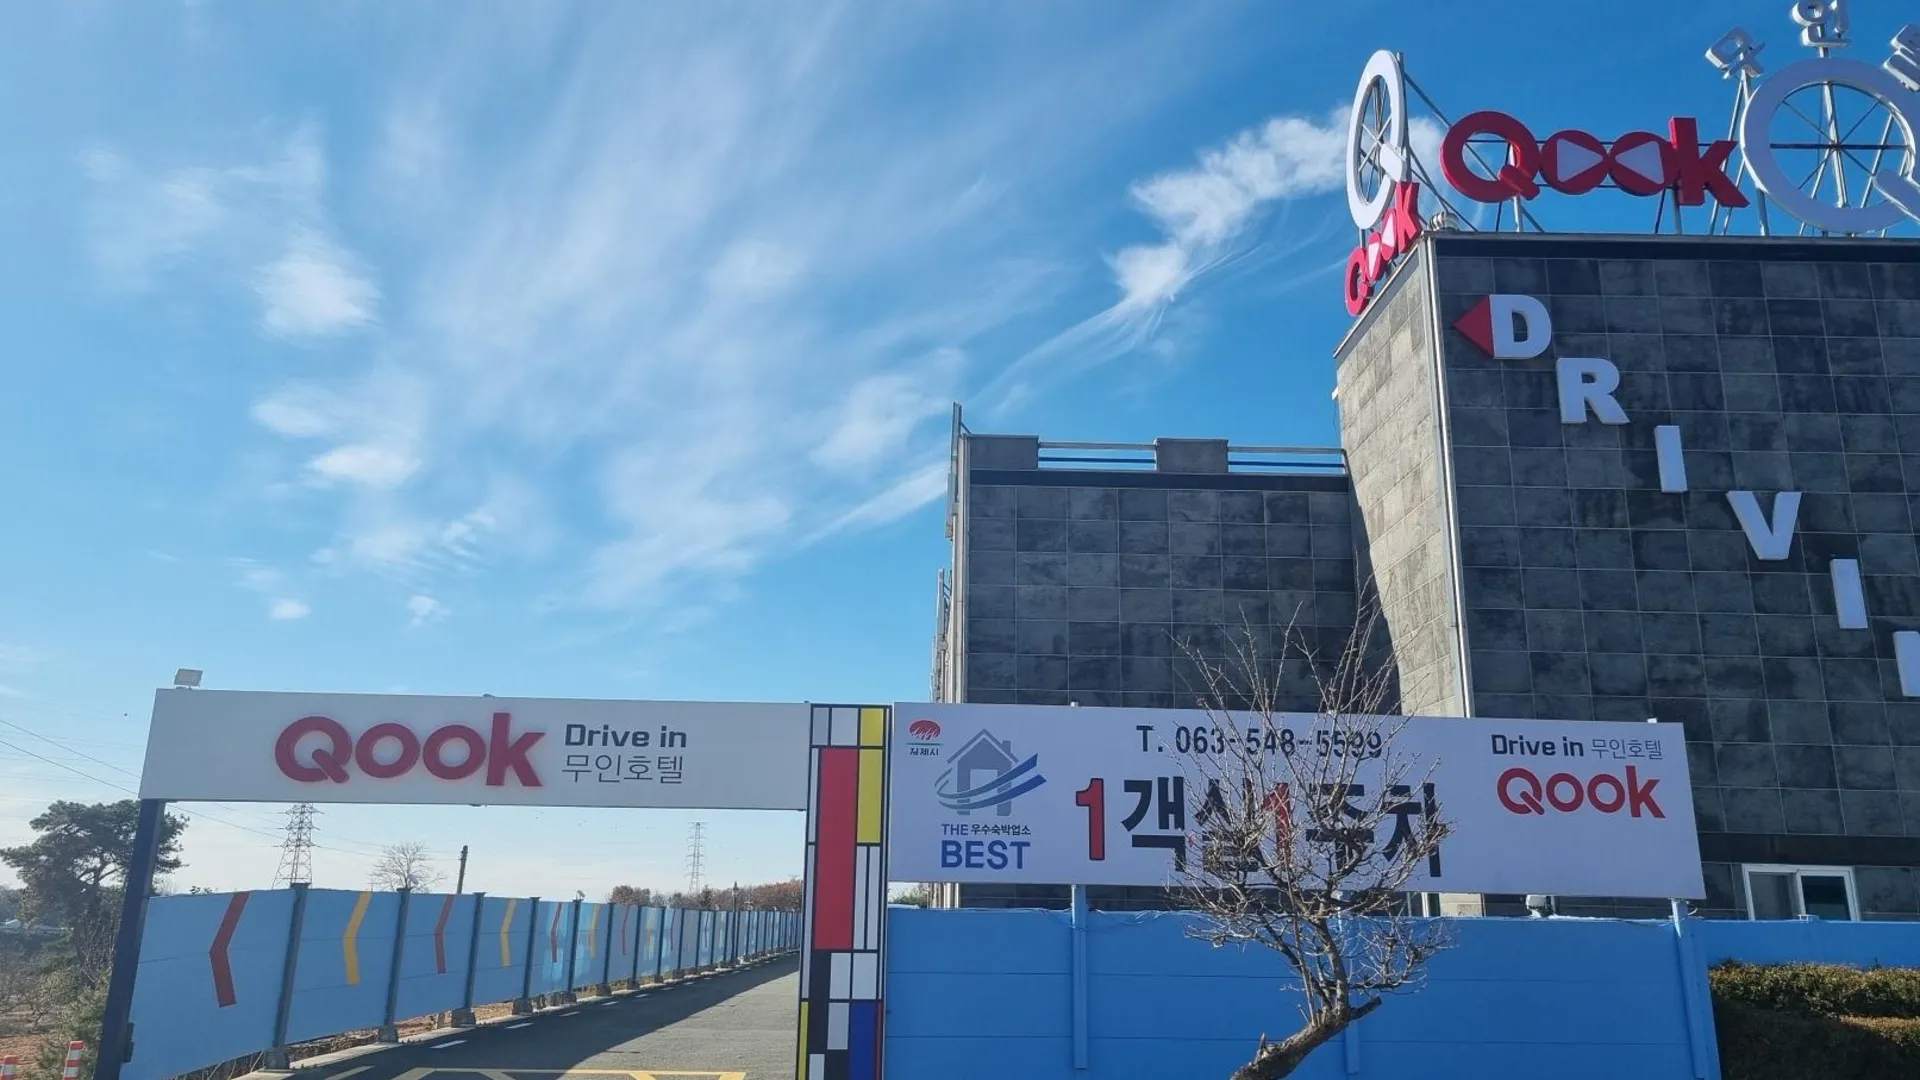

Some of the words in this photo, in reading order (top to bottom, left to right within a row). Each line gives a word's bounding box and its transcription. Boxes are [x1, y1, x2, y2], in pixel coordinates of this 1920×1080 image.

[1440, 110, 1750, 208] Qook
[275, 712, 546, 787] Qook
[565, 724, 650, 747] Drive
[660, 725, 687, 748] in
[1136, 725, 1163, 752] T.
[1491, 734, 1556, 756] Drive
[1562, 736, 1584, 757] in
[1591, 739, 1663, 760] 무인호텔
[562, 754, 683, 784] 무인호텔
[1496, 765, 1666, 819] Qook
[942, 823, 969, 836] THE
[970, 823, 1031, 836] 우수숙박업소
[941, 840, 1031, 870] BEST
